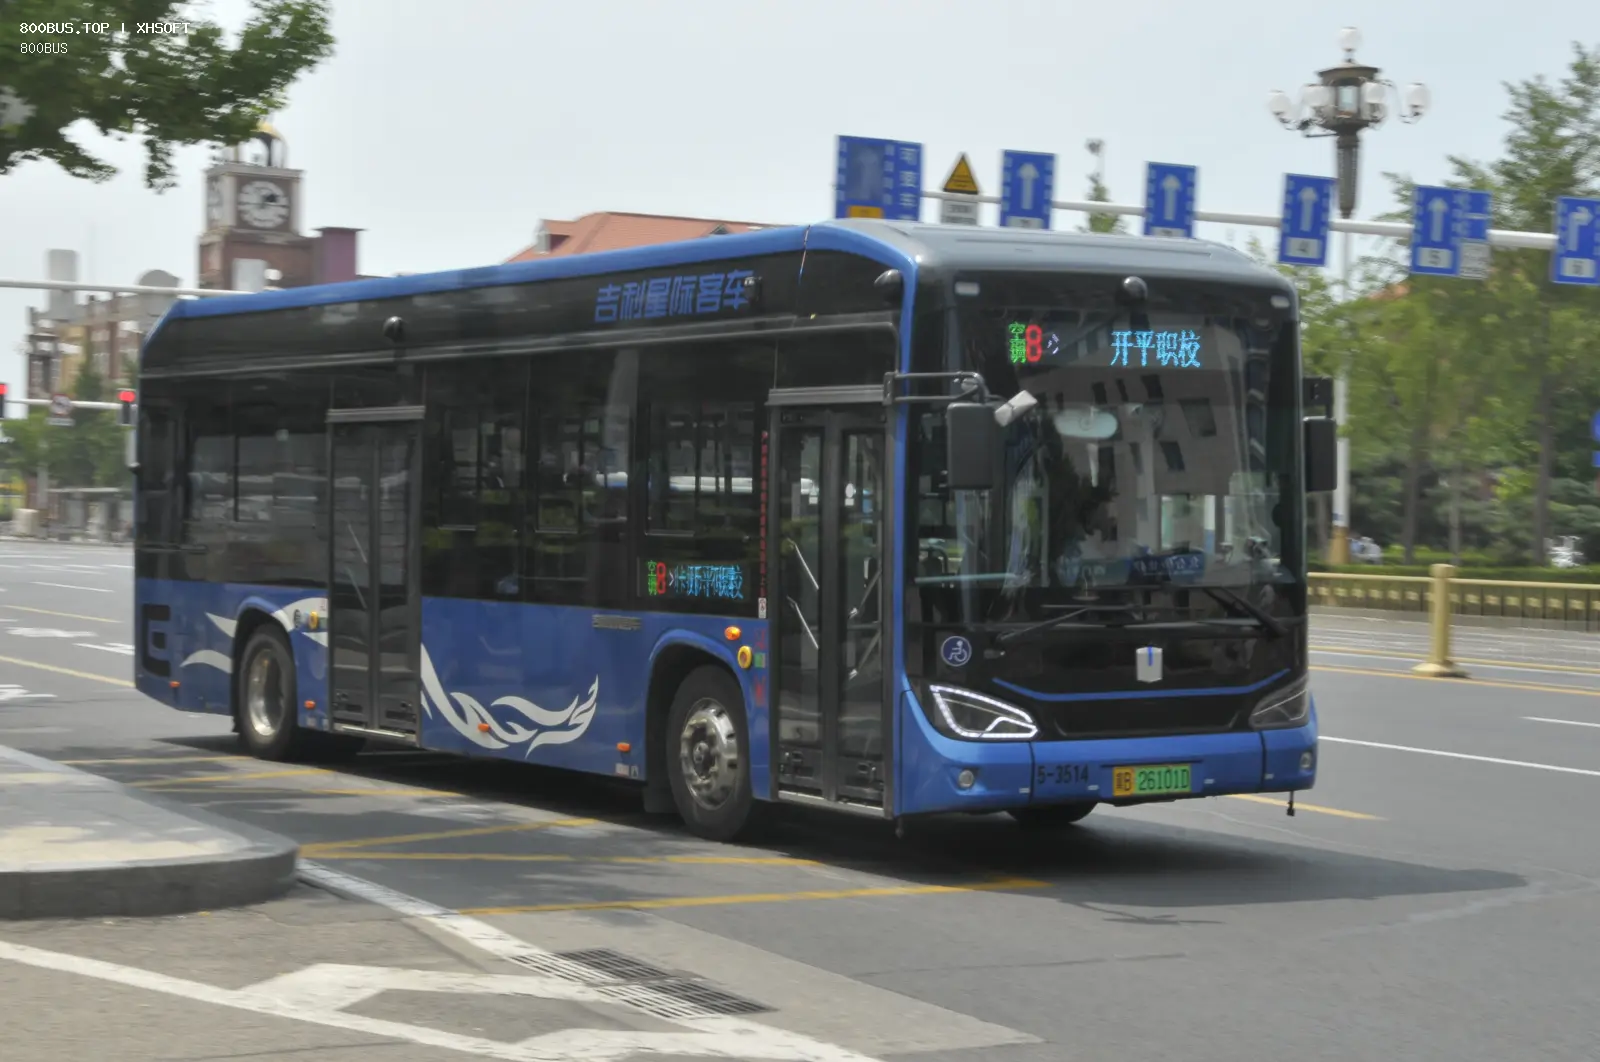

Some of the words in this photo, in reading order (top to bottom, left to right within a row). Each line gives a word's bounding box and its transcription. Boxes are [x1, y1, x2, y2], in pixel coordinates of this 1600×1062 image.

[593, 268, 755, 324] 吉利星际客车
[1008, 321, 1026, 364] 空调
[1025, 324, 1043, 362] 8
[1109, 328, 1201, 369] 开平职校
[656, 561, 667, 595] 8
[1036, 765, 1090, 785] 5-3514
[1138, 769, 1190, 791] 26101D
